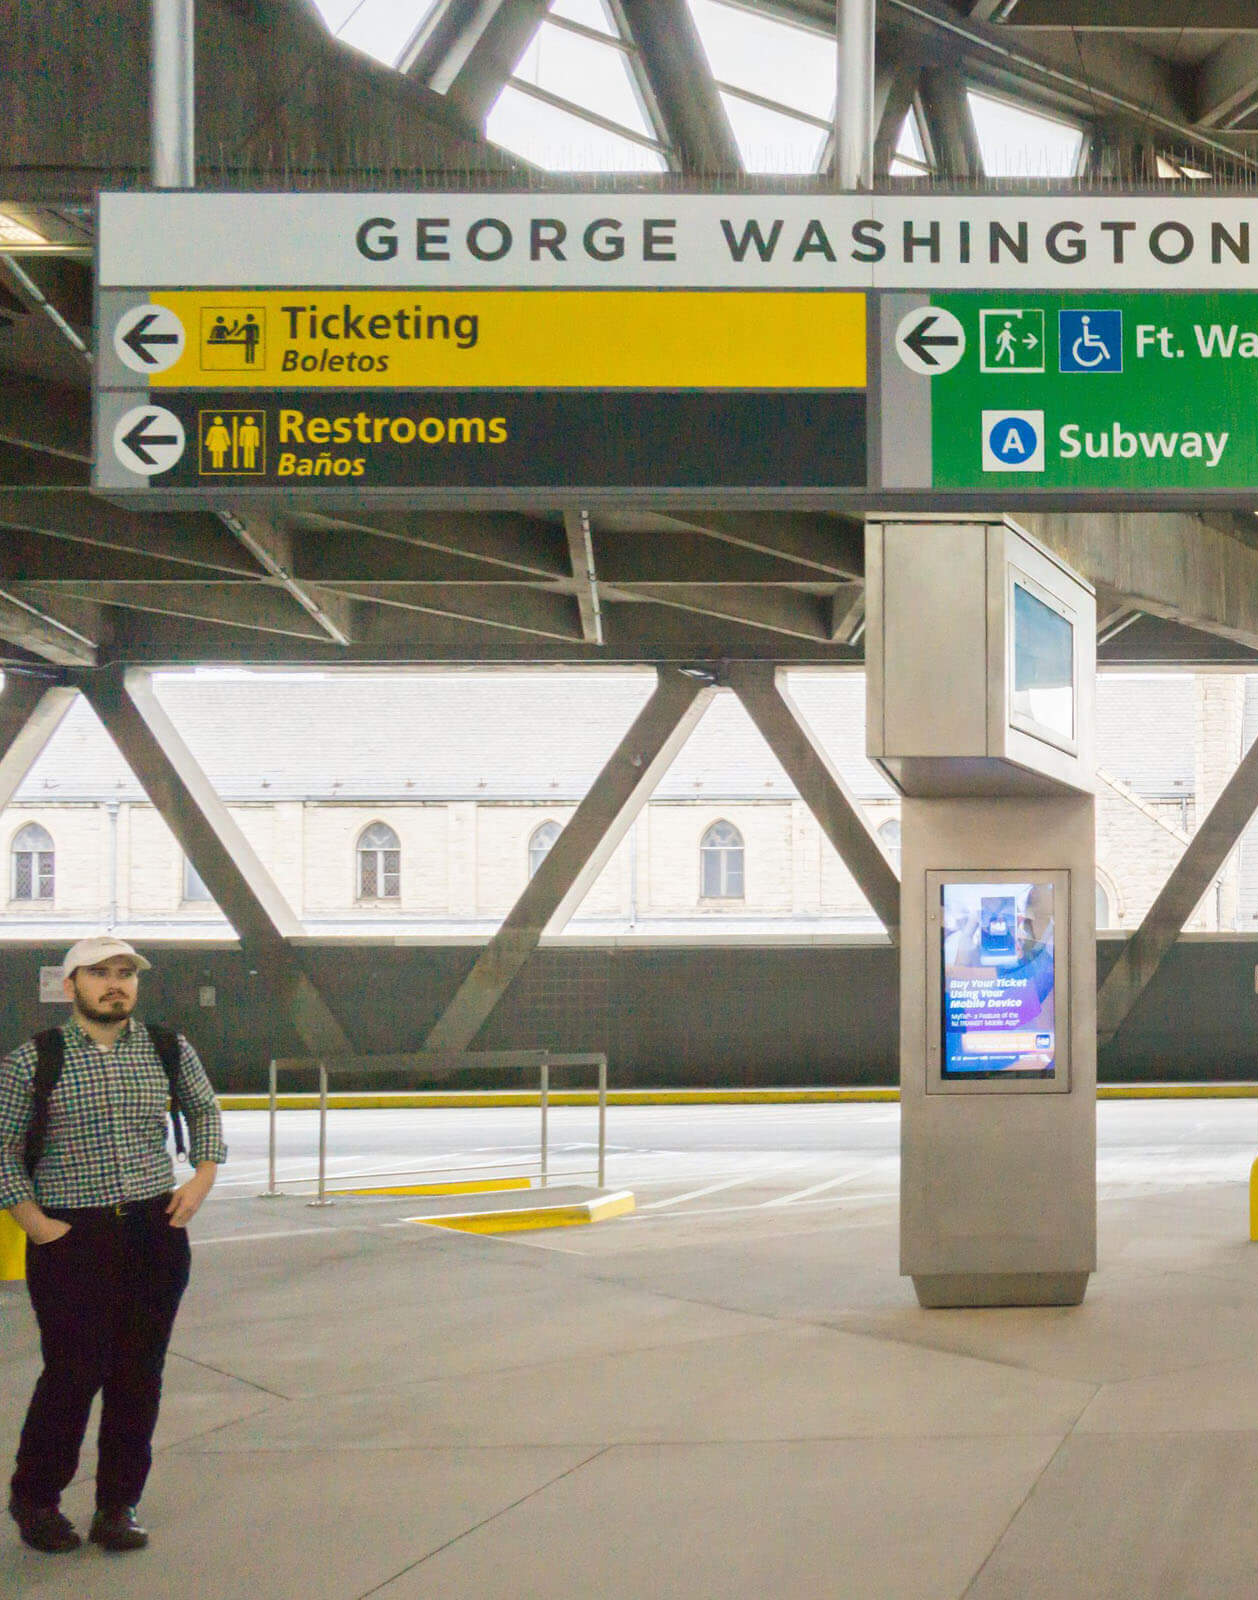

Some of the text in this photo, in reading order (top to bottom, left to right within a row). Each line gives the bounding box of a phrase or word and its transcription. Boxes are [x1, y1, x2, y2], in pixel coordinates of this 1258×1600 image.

[355, 217, 677, 263] GEORGE
[720, 219, 1250, 265] WASHINGTON
[281, 304, 479, 349] Ticketing
[1136, 324, 1185, 359] Ft.
[281, 349, 390, 373] Boletos
[279, 409, 508, 444] Restrooms
[1002, 428, 1025, 454] A
[1060, 421, 1229, 468] Subway
[277, 452, 366, 477] Baños
[950, 977, 1028, 990] Buy Your Ticket
[950, 989, 1005, 1000] Using Your
[950, 998, 1023, 1009] Mobile Device
